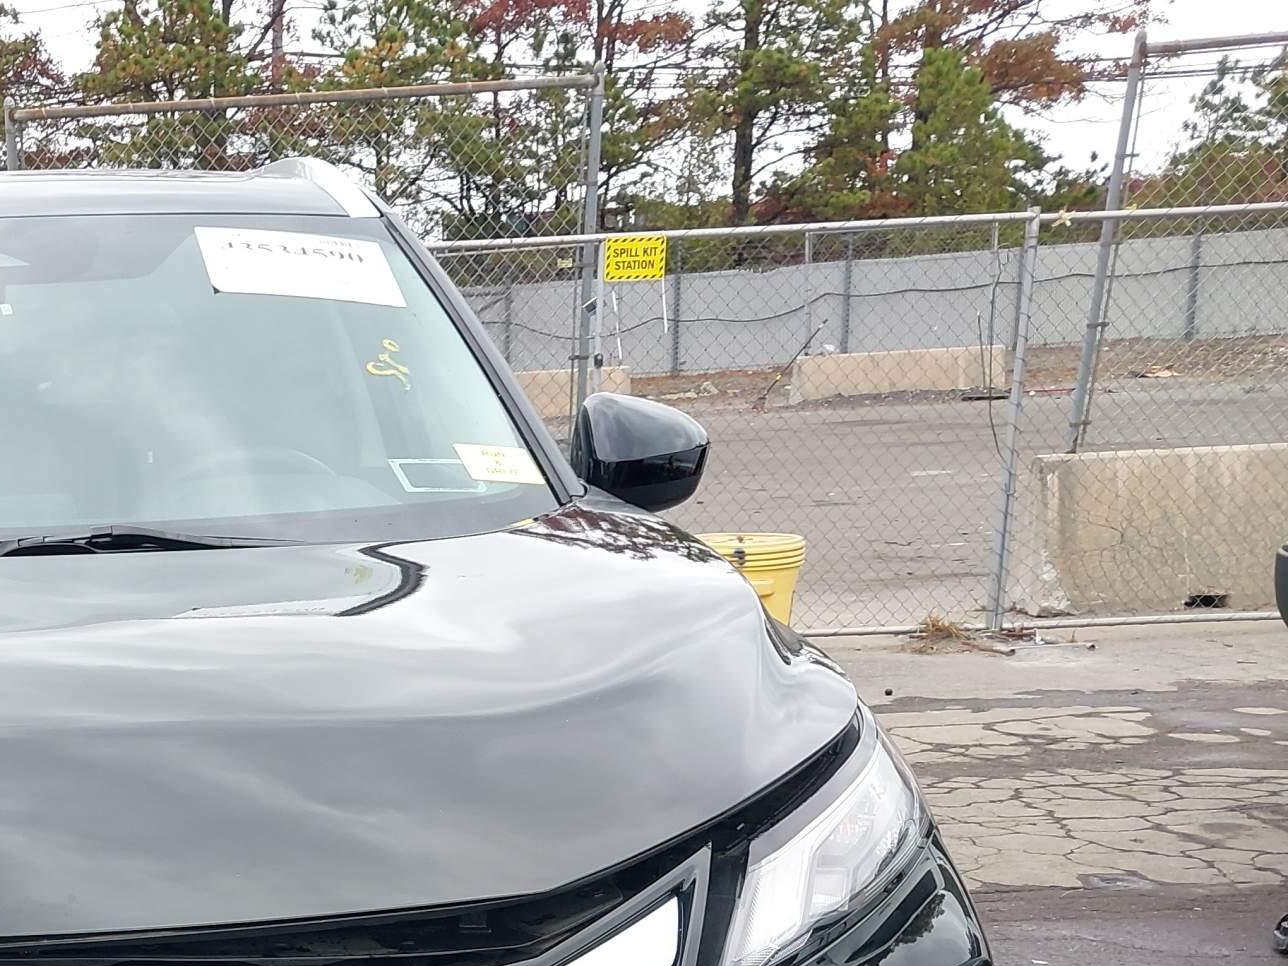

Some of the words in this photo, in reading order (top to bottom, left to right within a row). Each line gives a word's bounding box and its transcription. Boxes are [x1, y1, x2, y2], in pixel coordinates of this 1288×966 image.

[613, 248, 640, 258] SPILL
[642, 246, 659, 257] KIT
[614, 260, 655, 270] STATION
